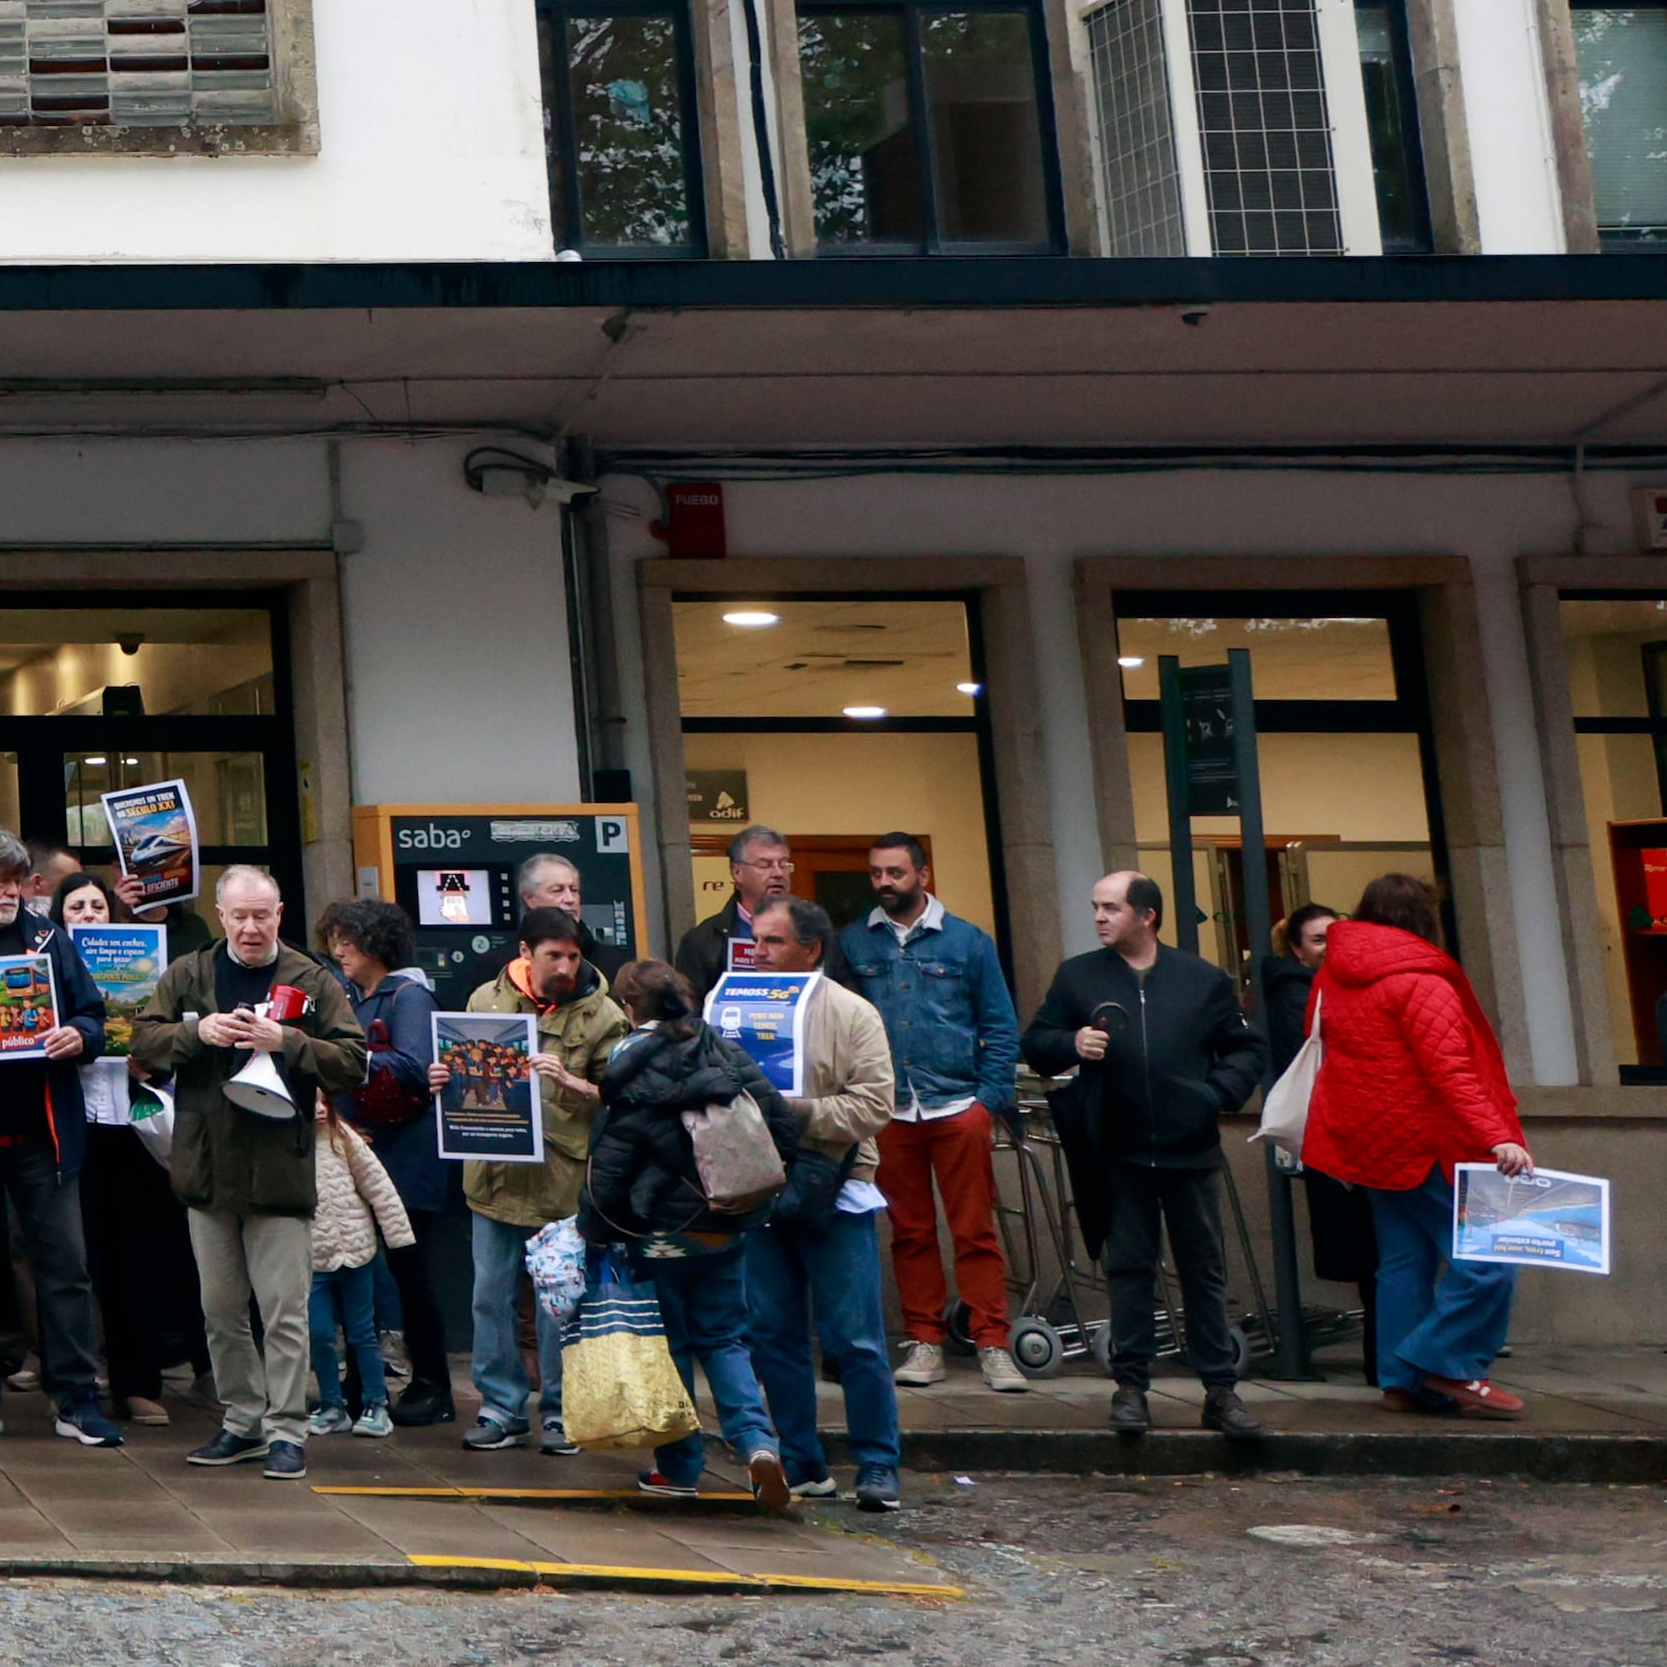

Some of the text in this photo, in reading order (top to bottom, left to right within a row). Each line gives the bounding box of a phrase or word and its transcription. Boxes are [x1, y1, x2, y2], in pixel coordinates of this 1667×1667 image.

[675, 494, 718, 506] FUEGO
[157, 791, 175, 802] TREN
[125, 804, 157, 817] SÉCULO
[158, 800, 176, 811] XXI
[709, 807, 744, 818] adif
[602, 822, 620, 847] P
[82, 936, 109, 947] Cidades
[768, 989, 789, 1000] 5G
[2, 1036, 35, 1050] público
[1497, 1236, 1557, 1247] porto exterior
[1545, 1248, 1562, 1258] Sen
